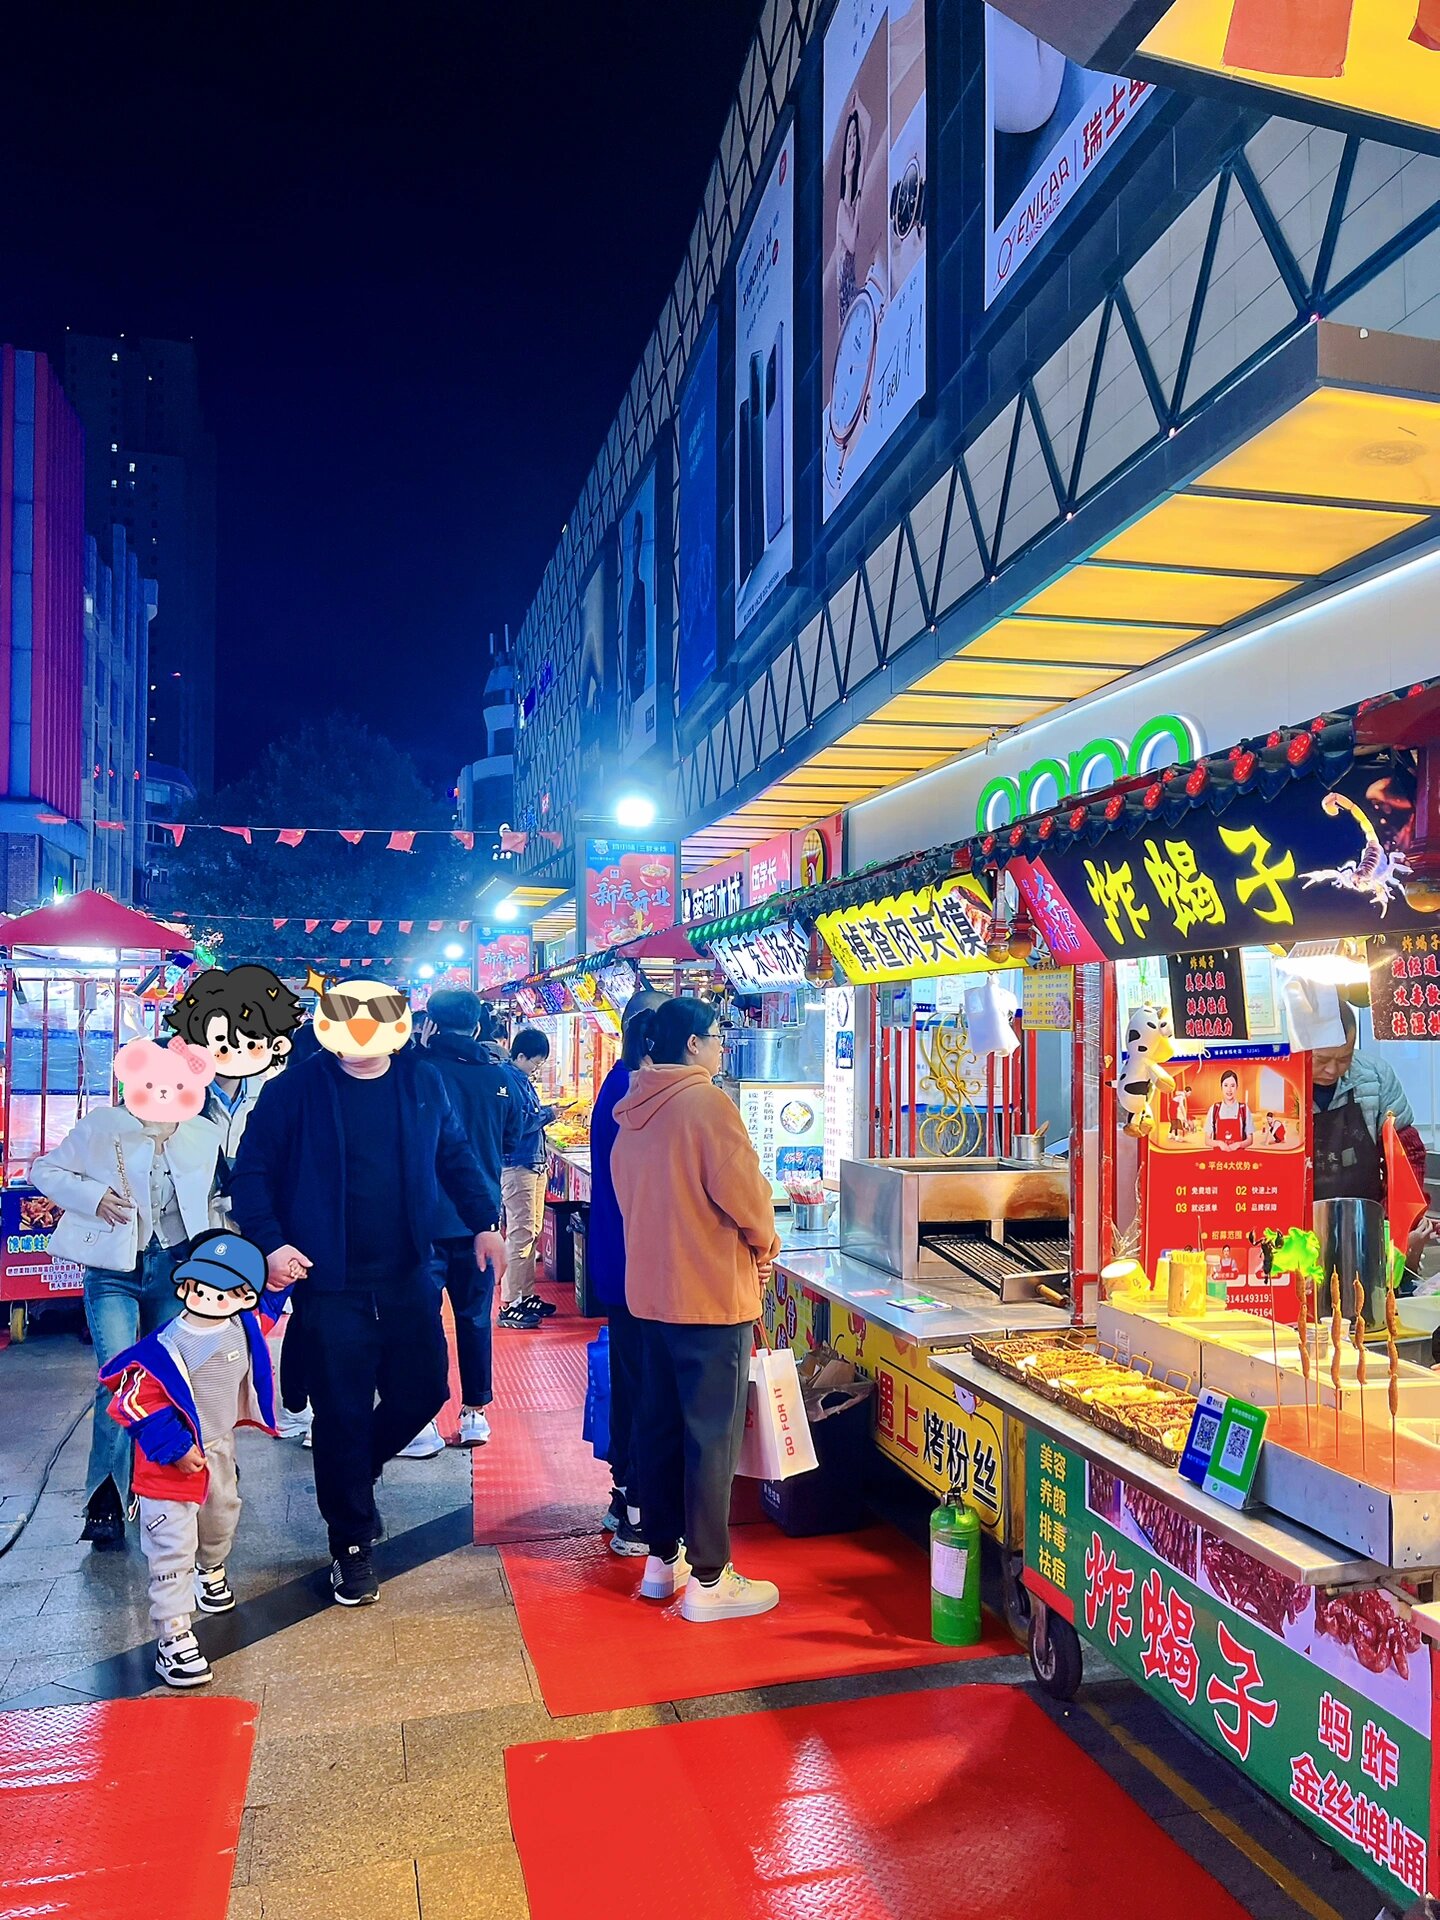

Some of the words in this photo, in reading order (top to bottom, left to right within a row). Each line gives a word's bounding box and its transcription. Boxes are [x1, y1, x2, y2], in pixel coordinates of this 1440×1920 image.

[1017, 157, 1070, 245] ENICAR
[1025, 219, 1043, 247] SWISS
[1043, 193, 1061, 222] MADE
[877, 338, 900, 428] Feel
[1083, 825, 1298, 945] 炸蝎子
[1402, 933, 1440, 954] 炸蝎子
[1189, 955, 1215, 970] 炸蝎子
[1208, 1161, 1251, 1170] 平台4大优势
[1176, 1186, 1187, 1196] 01
[1235, 1186, 1247, 1196] 02
[1251, 1186, 1278, 1195] 快速上岗
[1175, 1203, 1187, 1213] 03
[1235, 1203, 1247, 1212] 04
[1251, 1203, 1277, 1212] 品牌保障
[7, 1233, 52, 1253] 馋嘴蛙
[1211, 1230, 1242, 1240] 招募范围
[773, 1387, 783, 1399] IT
[778, 1403, 791, 1431] FOR
[785, 1436, 795, 1456] GO
[1039, 1445, 1067, 1480] 美容
[1039, 1478, 1067, 1519] 养颜
[1039, 1511, 1067, 1554] 排毒
[1038, 1548, 1067, 1591] 祛痘
[1084, 1531, 1279, 1762] 炸蝎子
[1318, 1690, 1400, 1791] 蚂蚱
[1289, 1750, 1428, 1896] 金丝蝉蛹
